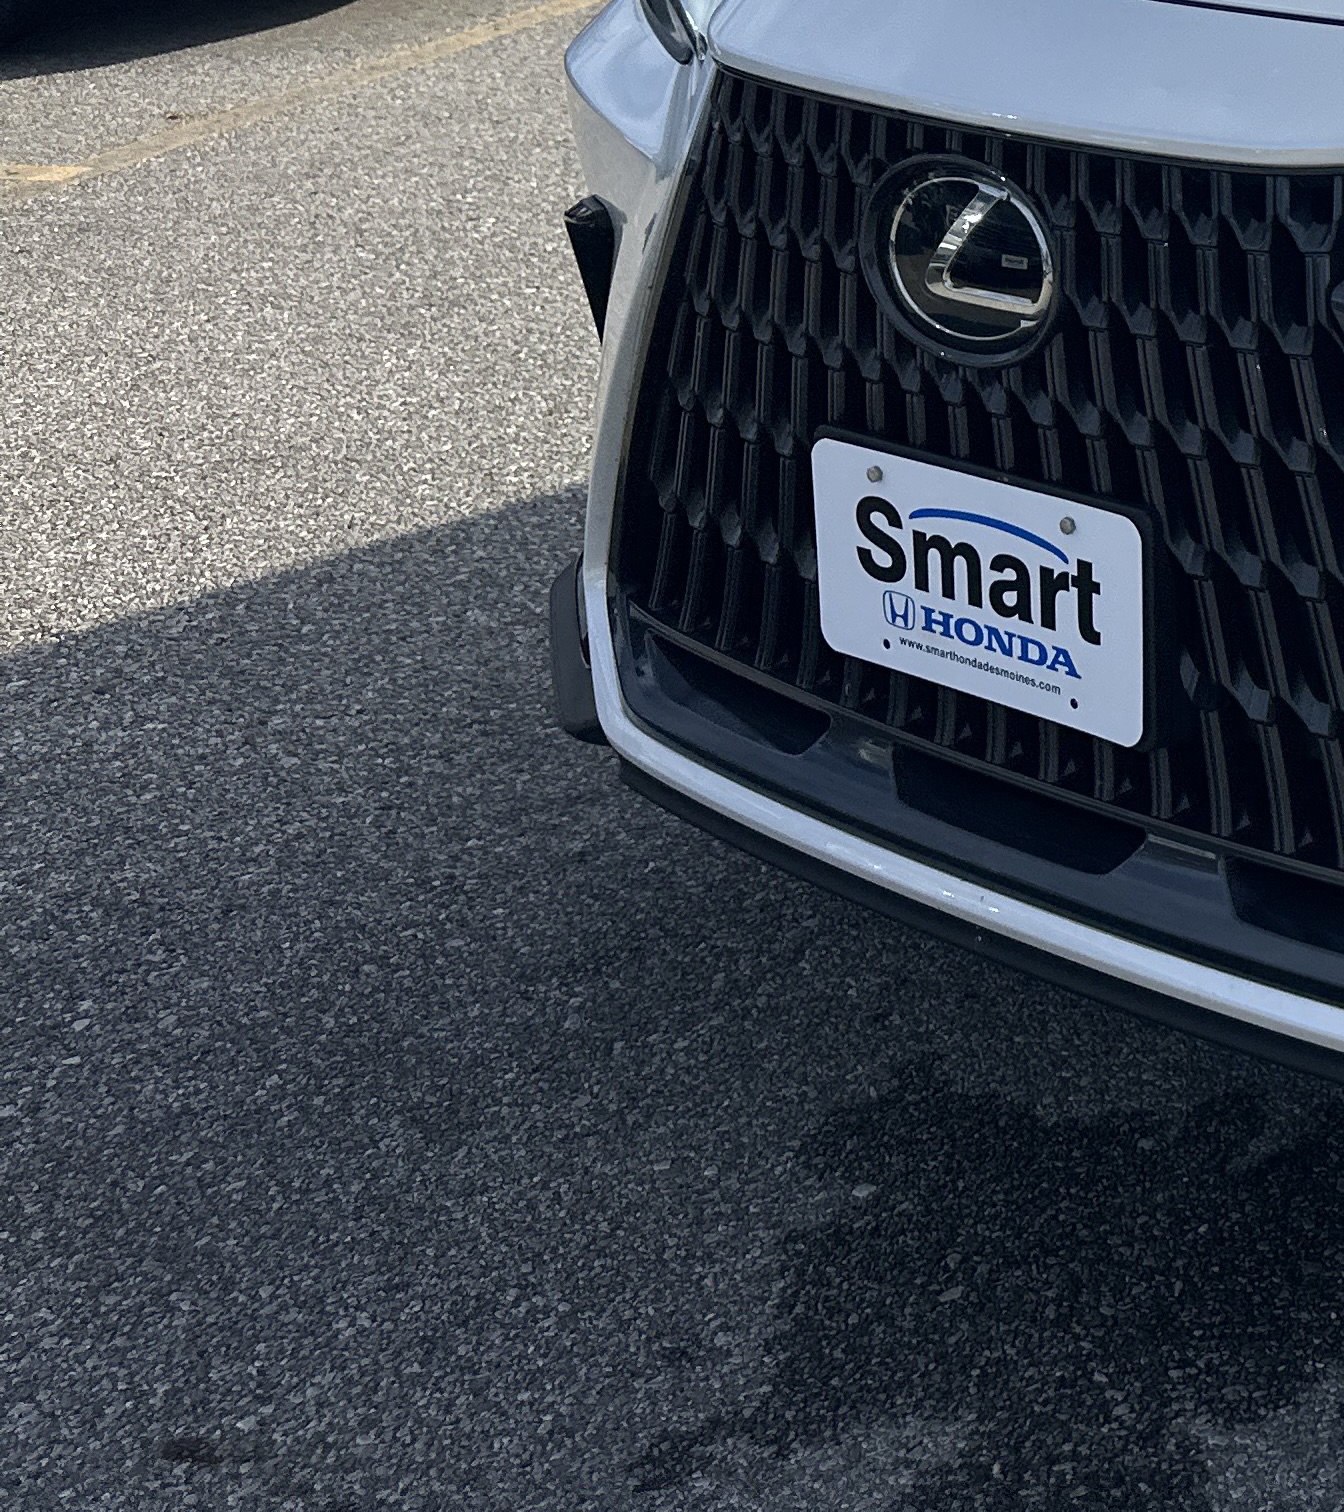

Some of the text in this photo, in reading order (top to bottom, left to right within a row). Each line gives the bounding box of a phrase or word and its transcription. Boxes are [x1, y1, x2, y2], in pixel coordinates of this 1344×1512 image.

[855, 495, 1102, 646] Smart
[898, 636, 1062, 696] www.smarthondadesmoines.com
[920, 604, 1082, 679] HONDA
